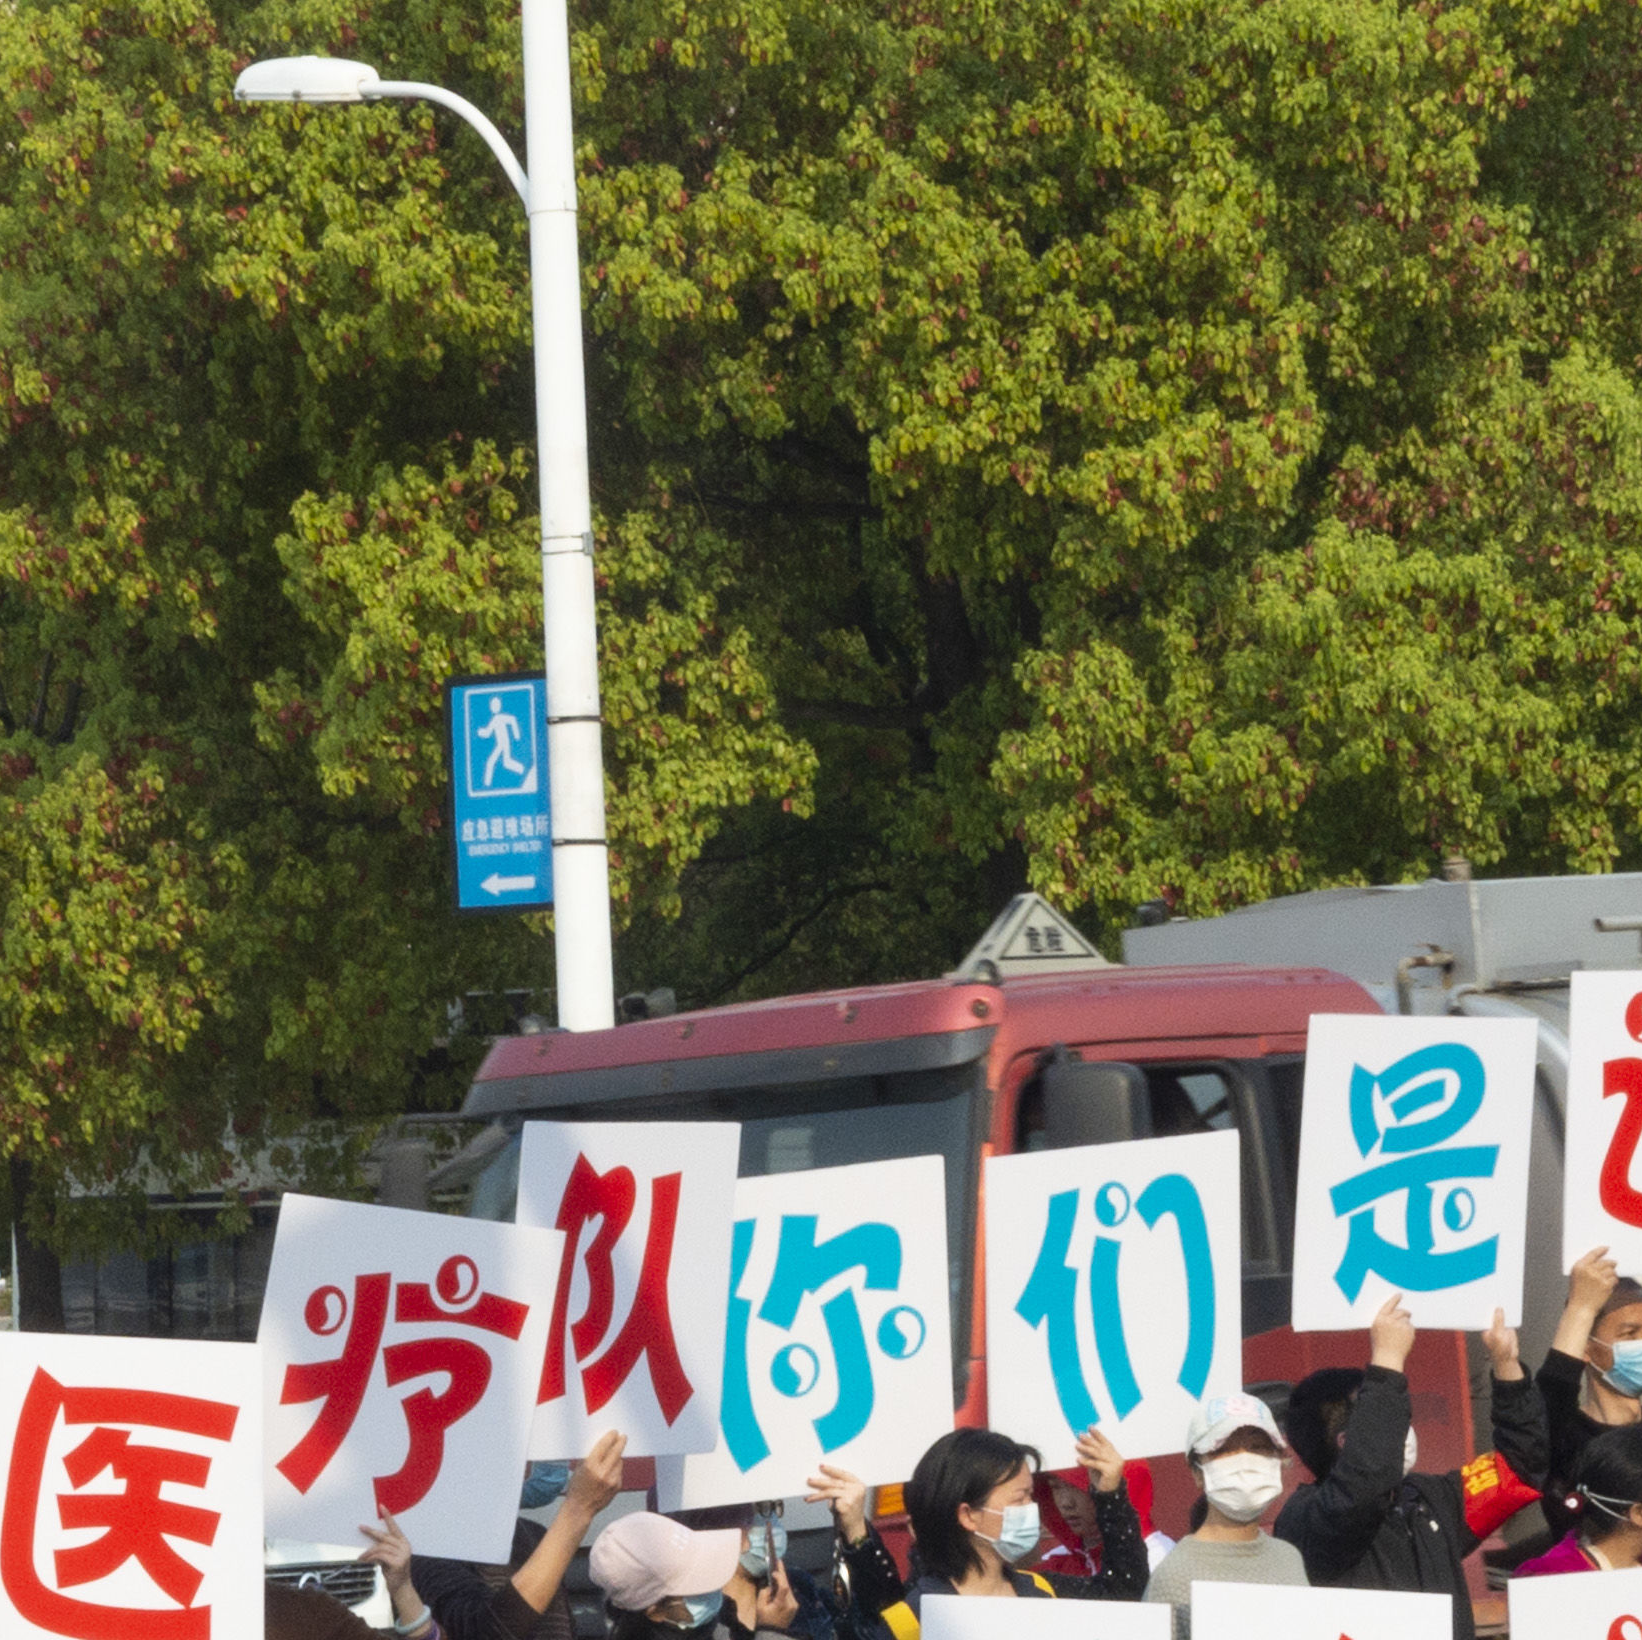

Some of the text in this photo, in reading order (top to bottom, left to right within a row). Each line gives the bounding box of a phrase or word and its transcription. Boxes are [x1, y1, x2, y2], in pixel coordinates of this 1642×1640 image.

[540, 1153, 694, 1426] 队
[1331, 1042, 1499, 1305] 是
[277, 1256, 528, 1514] 疗
[718, 1214, 928, 1472] 你
[1016, 1174, 1215, 1434] 们
